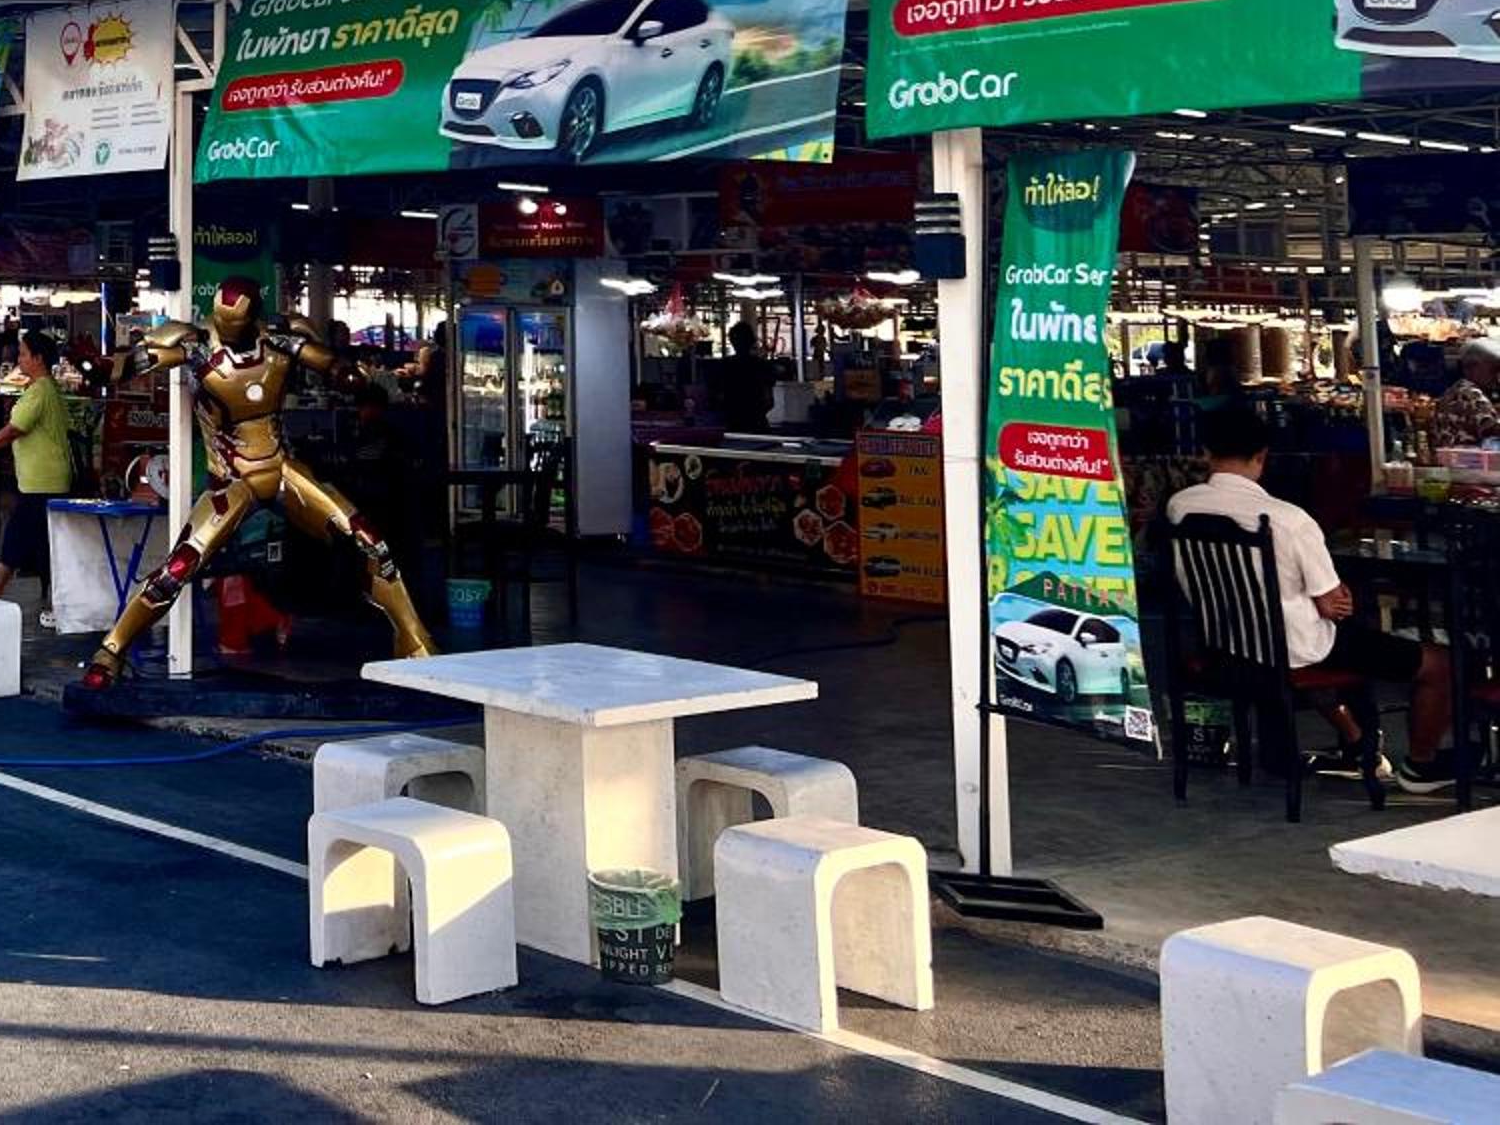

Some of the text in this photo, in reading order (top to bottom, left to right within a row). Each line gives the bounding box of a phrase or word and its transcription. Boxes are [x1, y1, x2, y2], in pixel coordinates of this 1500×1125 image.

[236, 4, 460, 62] ในพัทยา ราคาดีสุด
[888, 68, 1019, 111] GrabCar
[208, 137, 281, 161] GrabCar
[1004, 263, 1072, 287] GrabCar
